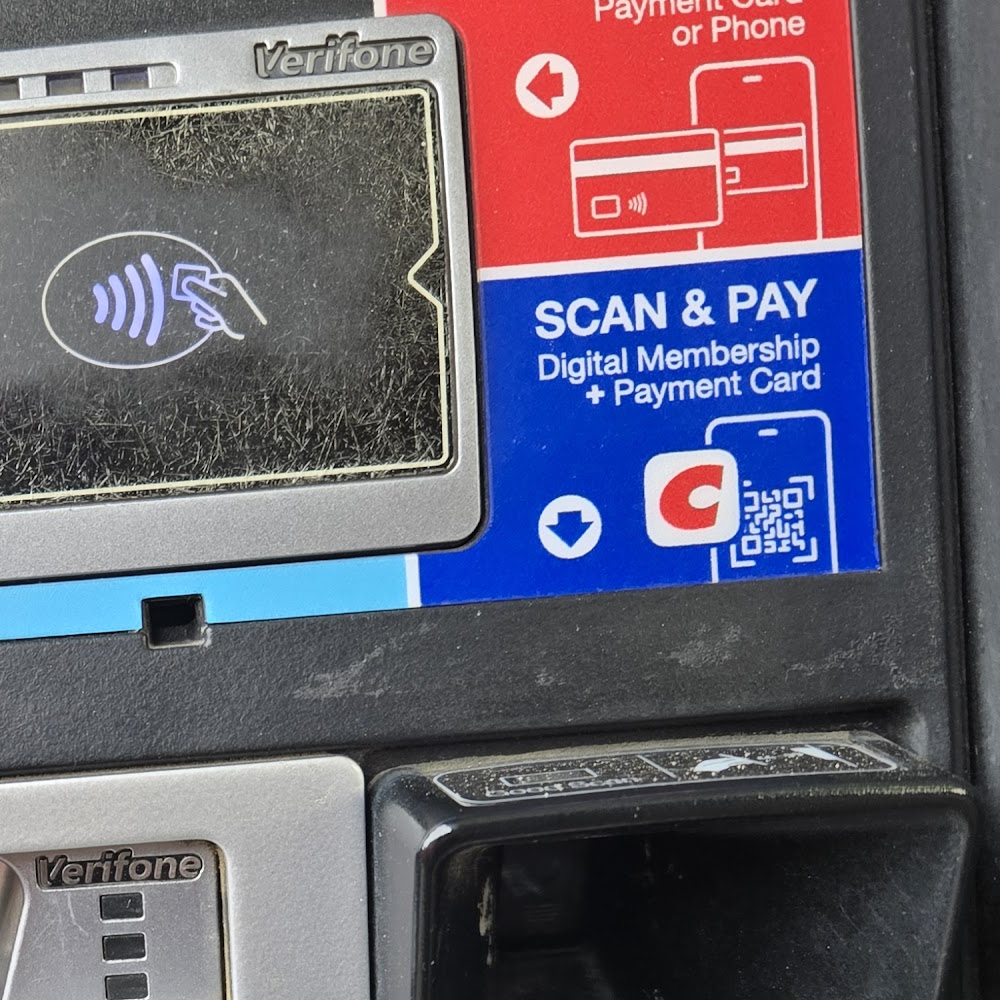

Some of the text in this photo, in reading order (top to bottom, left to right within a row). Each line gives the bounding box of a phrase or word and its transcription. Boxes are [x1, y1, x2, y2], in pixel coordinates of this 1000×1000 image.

[672, 15, 806, 46] or Phone
[255, 33, 435, 78] Verifone
[535, 278, 818, 340] SCAN & PAY
[538, 333, 820, 384] Digital Membership
[586, 364, 821, 409] + Payment Card
[36, 850, 203, 888] Verifone
